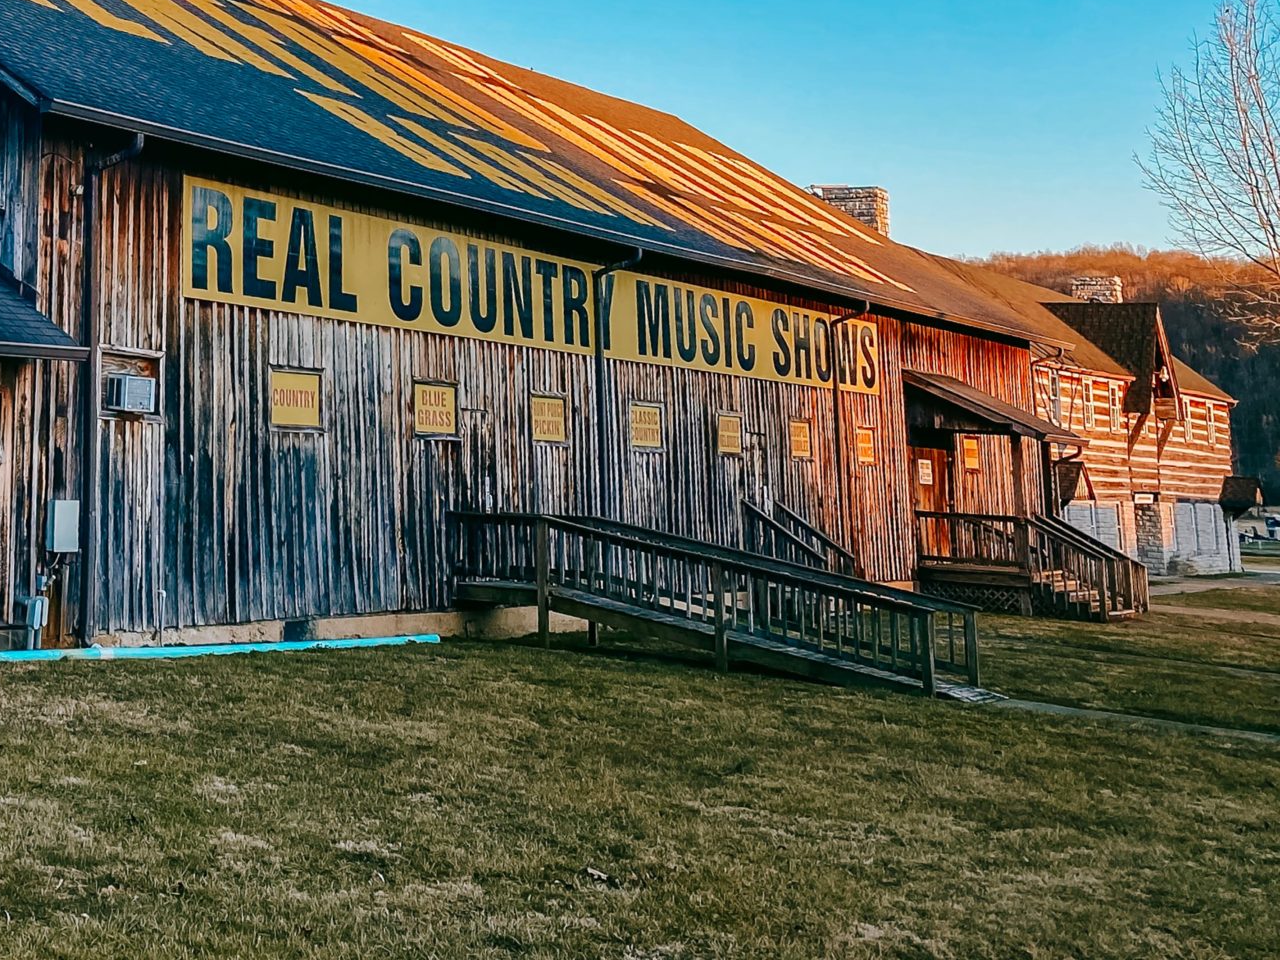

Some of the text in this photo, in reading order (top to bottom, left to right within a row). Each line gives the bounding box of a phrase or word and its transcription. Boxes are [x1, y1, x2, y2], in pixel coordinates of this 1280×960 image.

[449, 71, 885, 247] VALLEY
[293, 88, 918, 294] BARN DANCE
[191, 185, 877, 389] REAL COUNTRY MUSIC SHOWS
[273, 388, 316, 409] COUNTRY
[421, 390, 447, 408] BLUE
[533, 401, 546, 417] RONT
[417, 408, 452, 428] GRASS
